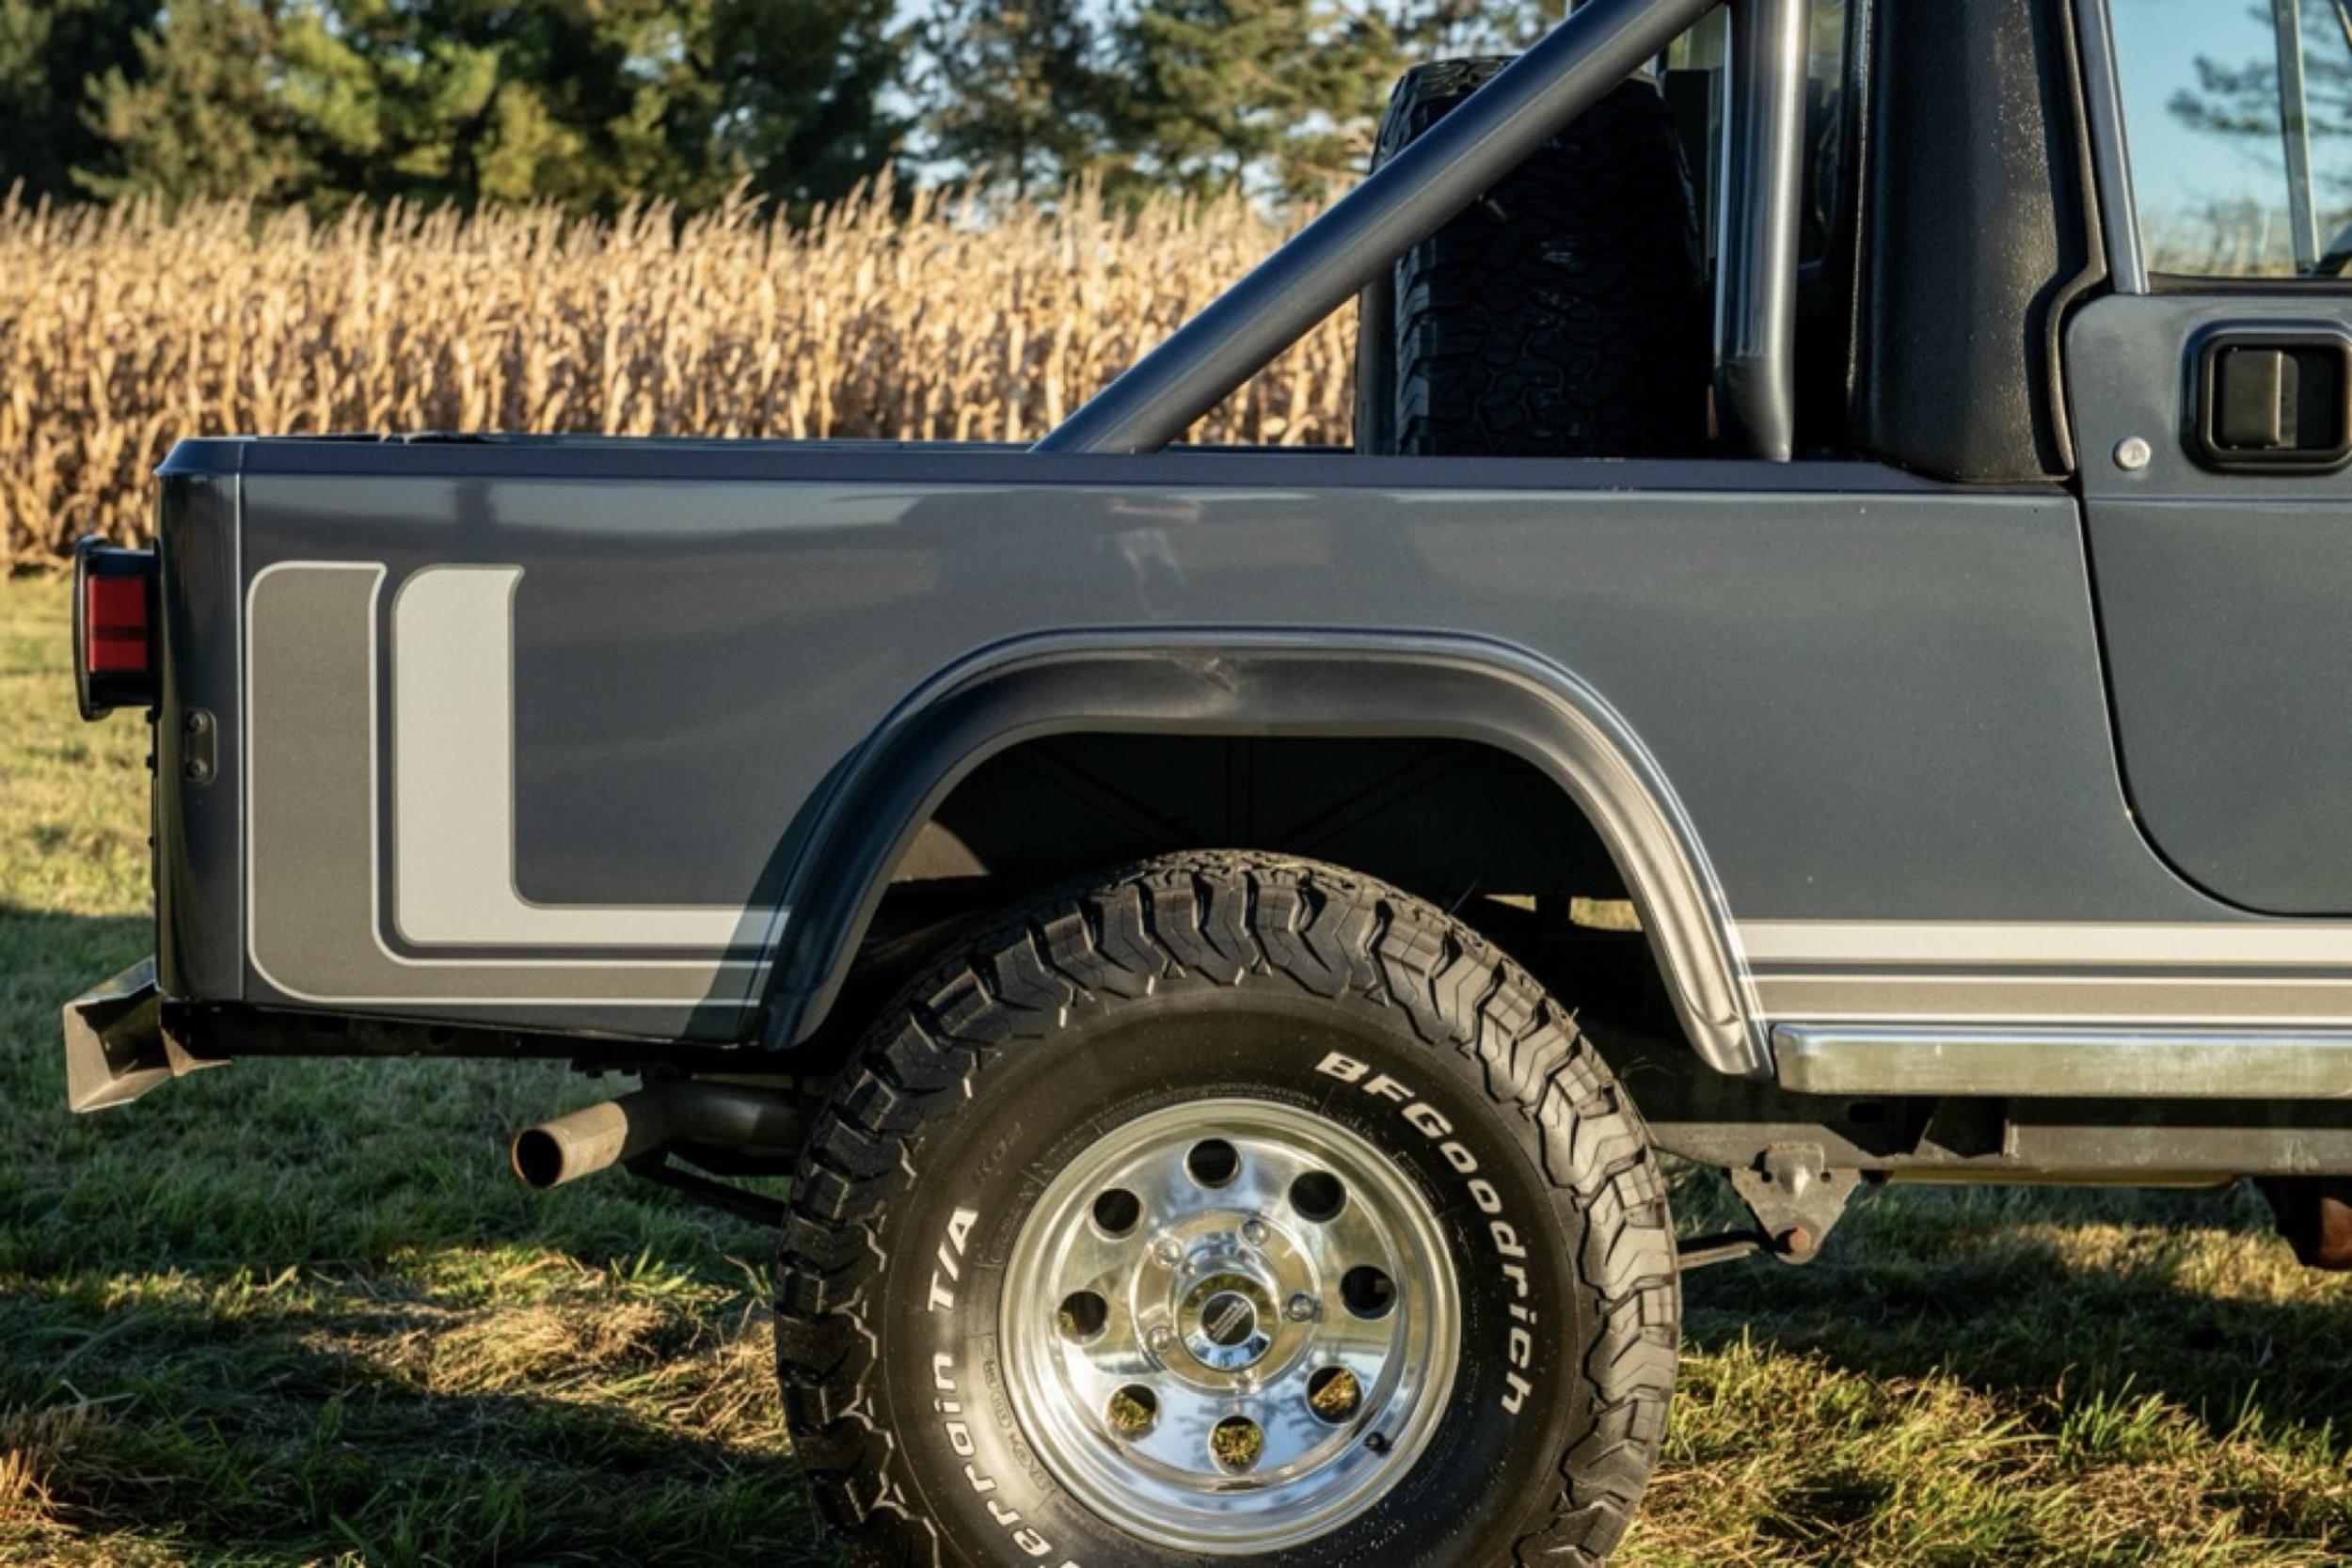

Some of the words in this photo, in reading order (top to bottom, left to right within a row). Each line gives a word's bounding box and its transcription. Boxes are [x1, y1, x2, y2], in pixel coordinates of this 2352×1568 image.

[927, 1207, 979, 1312] T/A
[1315, 1052, 1537, 1415] BFGoodrich
[932, 1353, 1080, 1568] errain
